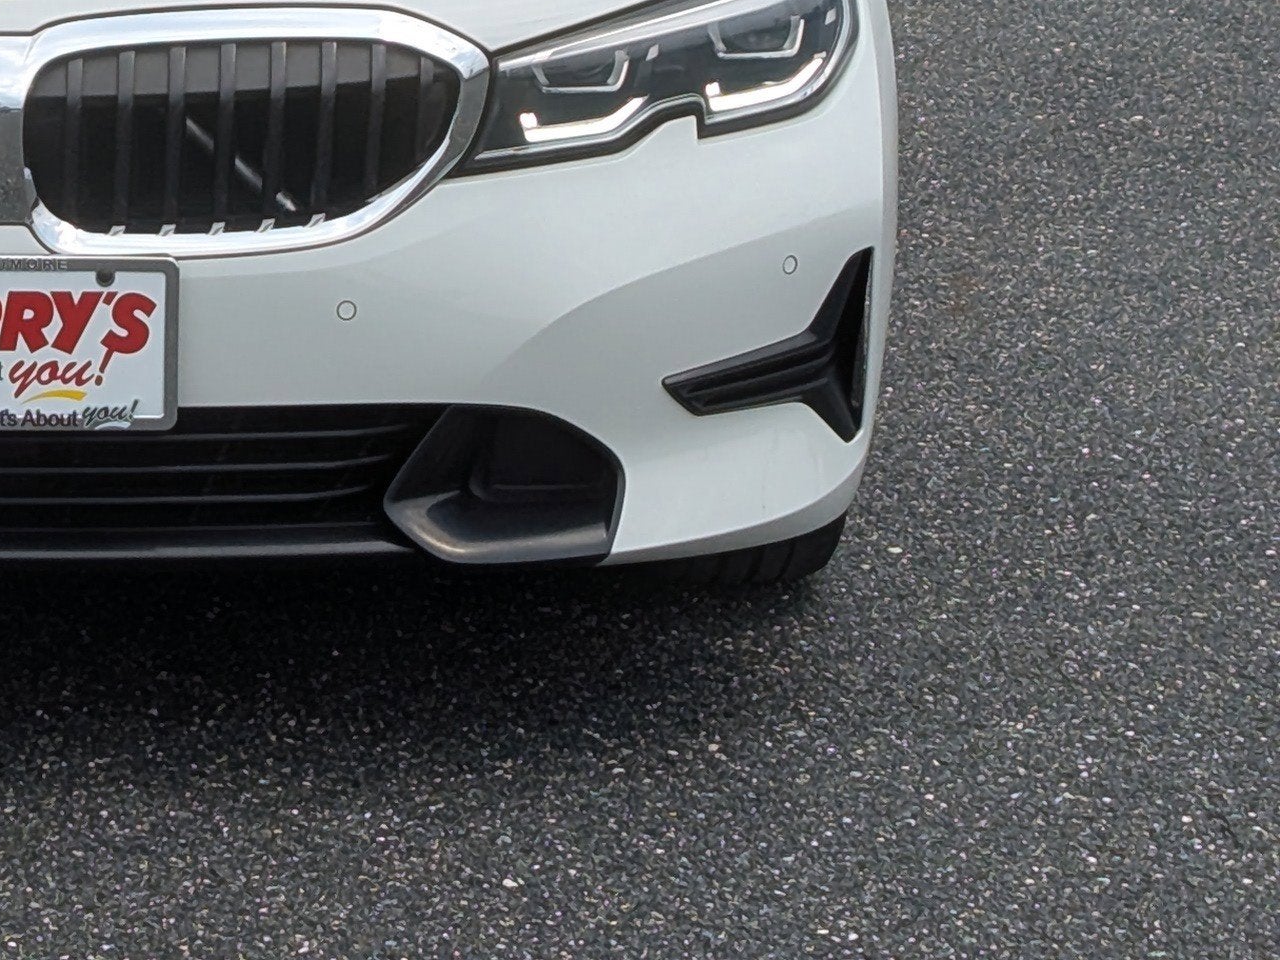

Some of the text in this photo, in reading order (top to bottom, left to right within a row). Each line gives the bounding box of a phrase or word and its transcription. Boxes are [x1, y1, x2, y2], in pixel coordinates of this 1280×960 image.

[9, 349, 116, 398] you!
[20, 409, 79, 428] About
[81, 399, 140, 428] you!
